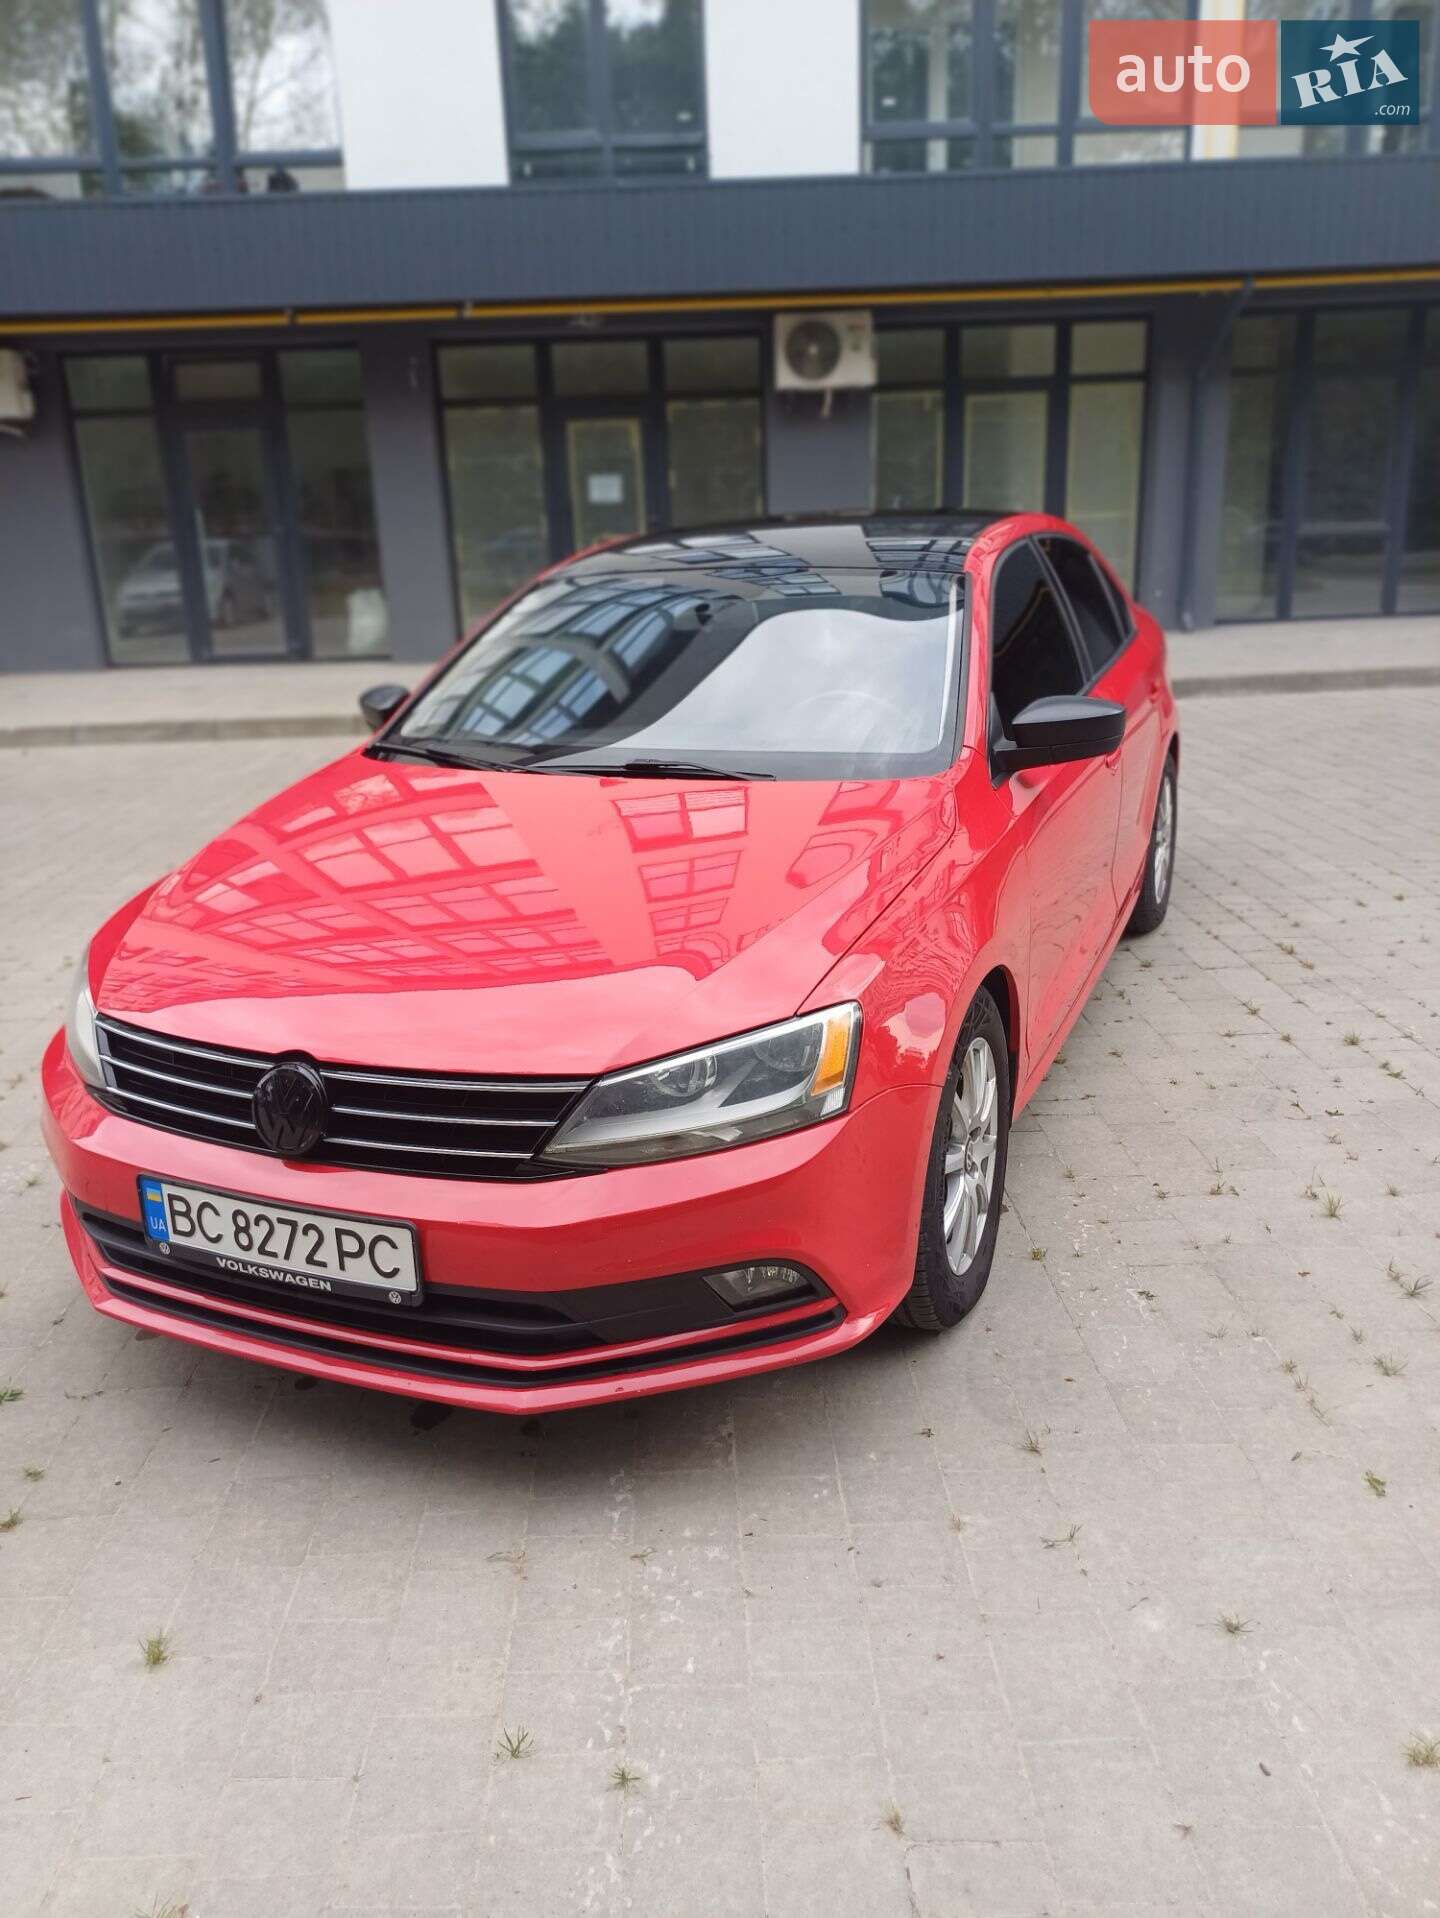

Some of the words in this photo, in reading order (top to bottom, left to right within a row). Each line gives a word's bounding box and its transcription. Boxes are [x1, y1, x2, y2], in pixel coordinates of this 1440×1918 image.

[150, 1215, 167, 1232] UA
[167, 1193, 223, 1244] BC
[231, 1209, 328, 1269] 8272
[335, 1227, 400, 1279] PC
[215, 1256, 332, 1293] VOLKSWAGEN
